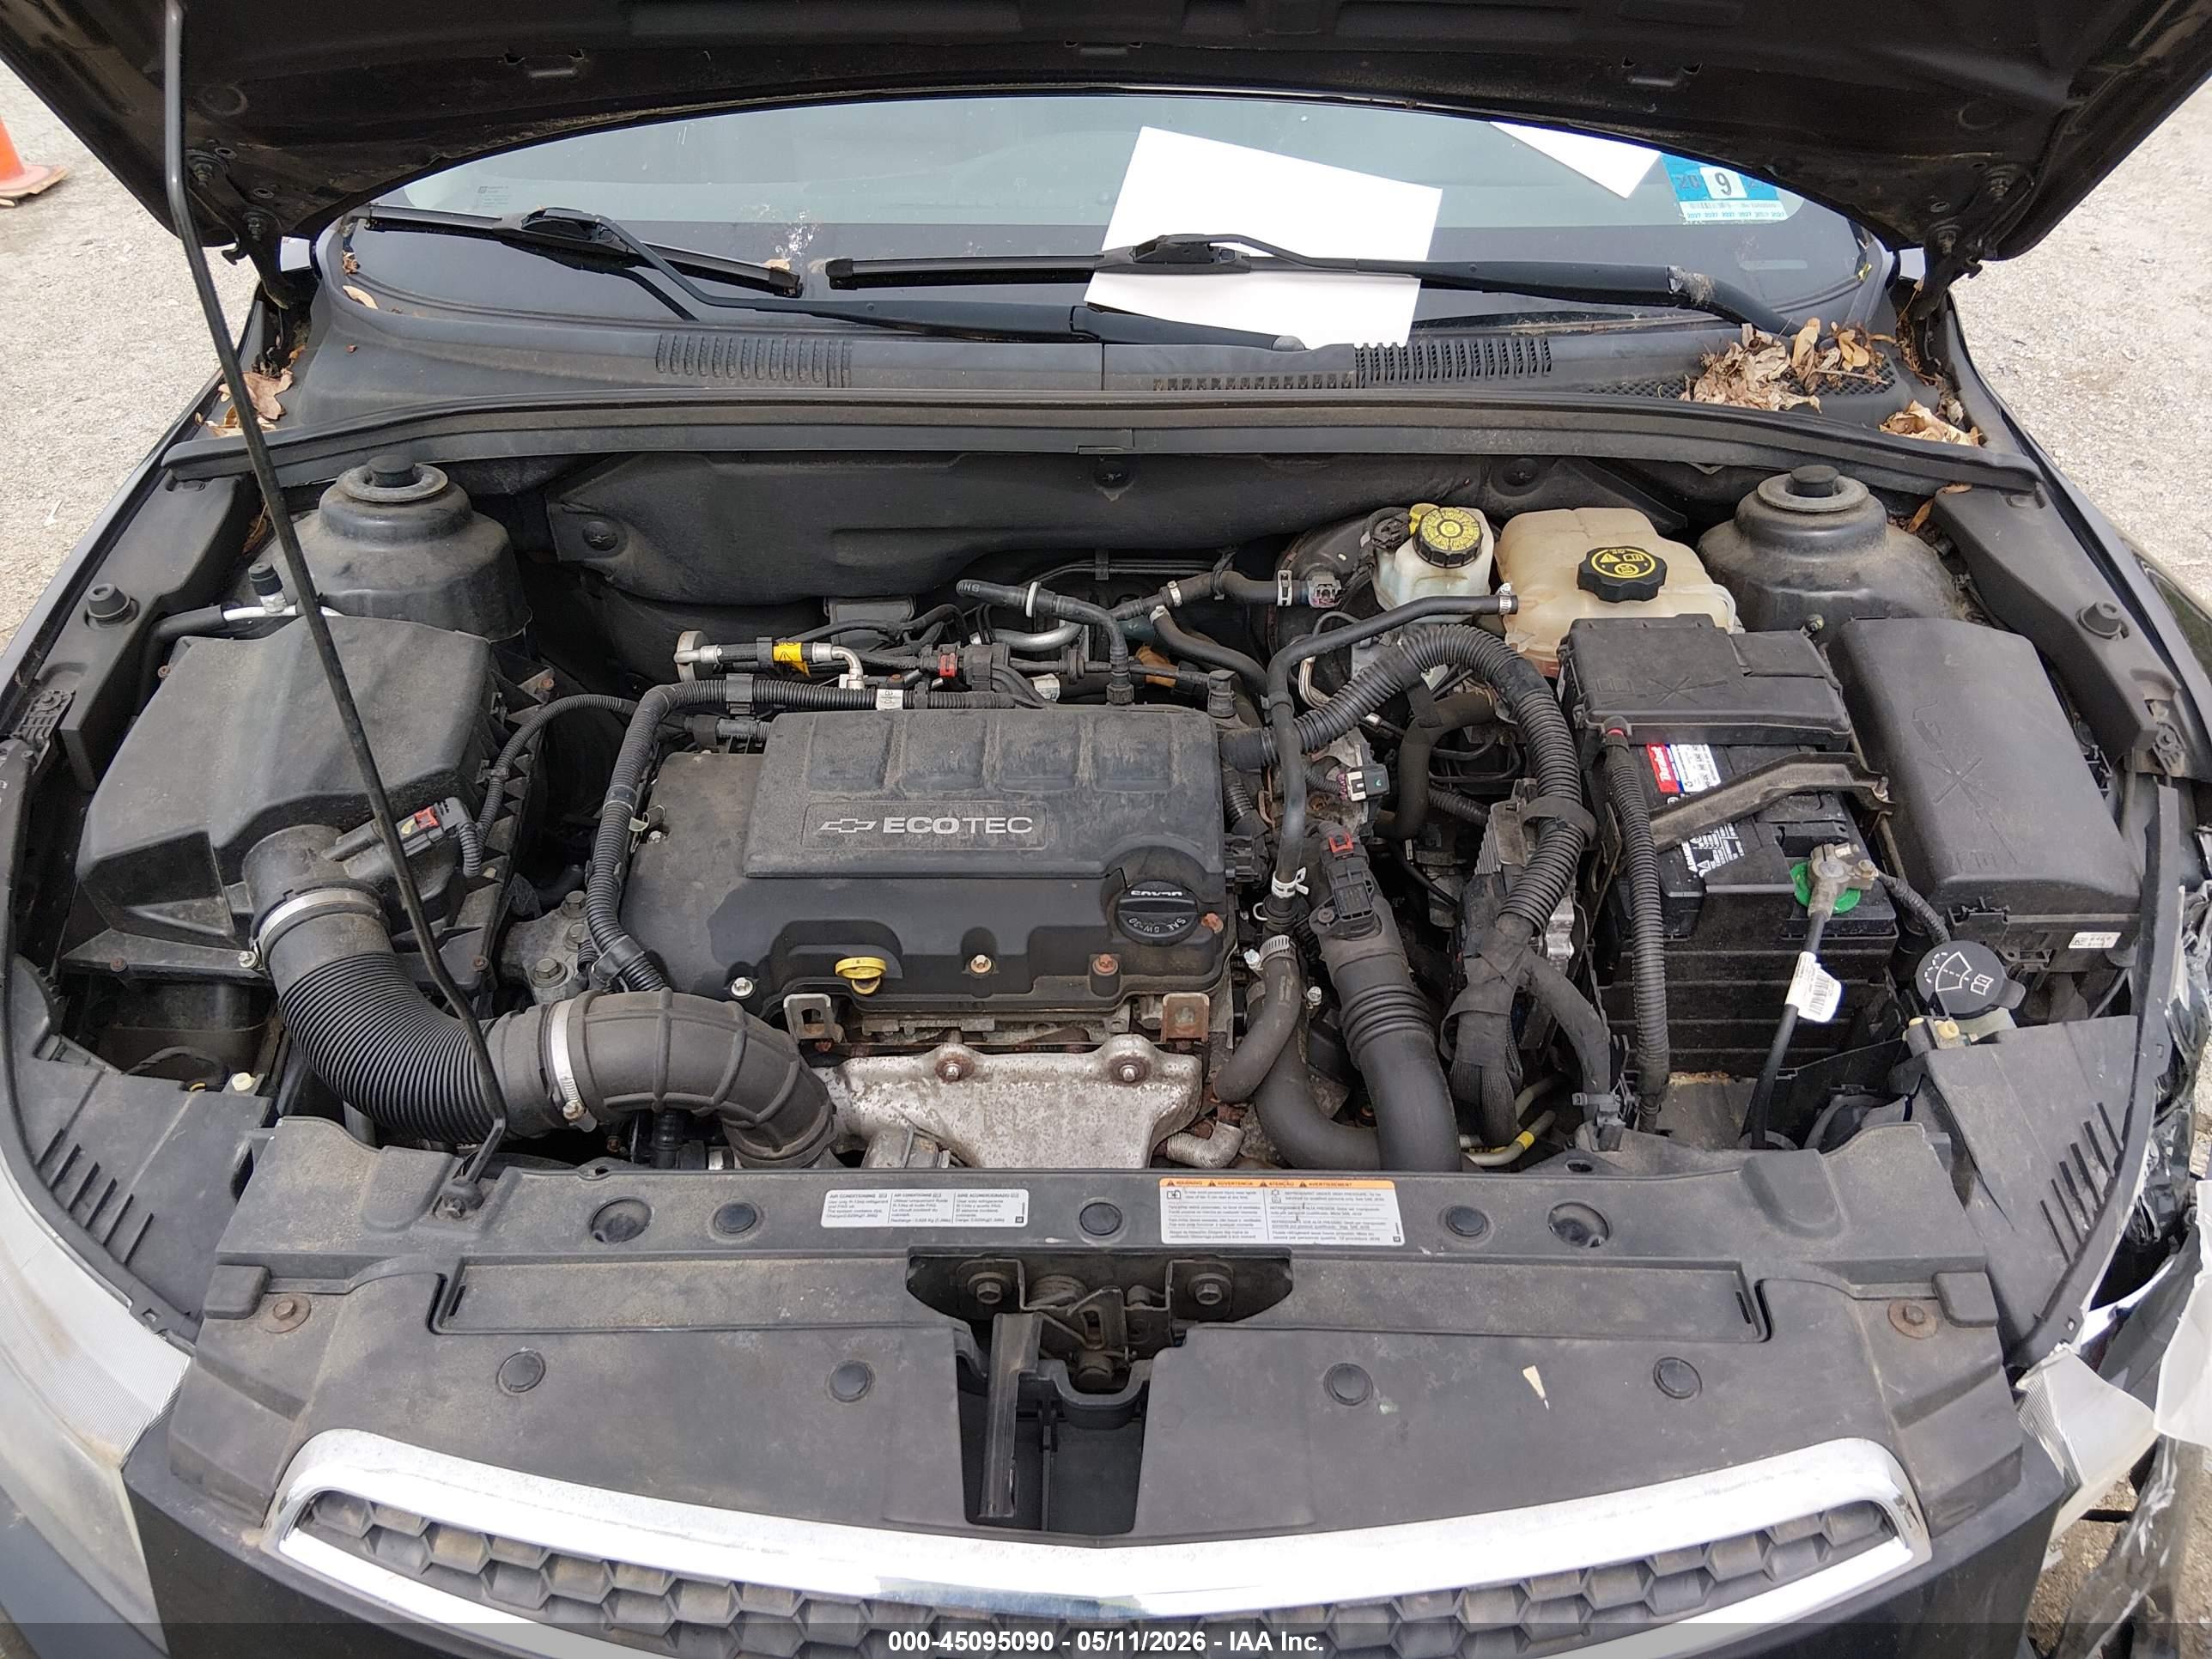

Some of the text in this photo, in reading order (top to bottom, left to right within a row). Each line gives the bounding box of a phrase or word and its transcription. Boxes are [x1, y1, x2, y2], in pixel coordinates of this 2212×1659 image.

[1714, 172, 1732, 196] 9
[883, 817, 1033, 835] ECOTEC
[1167, 917, 1187, 932] SAE
